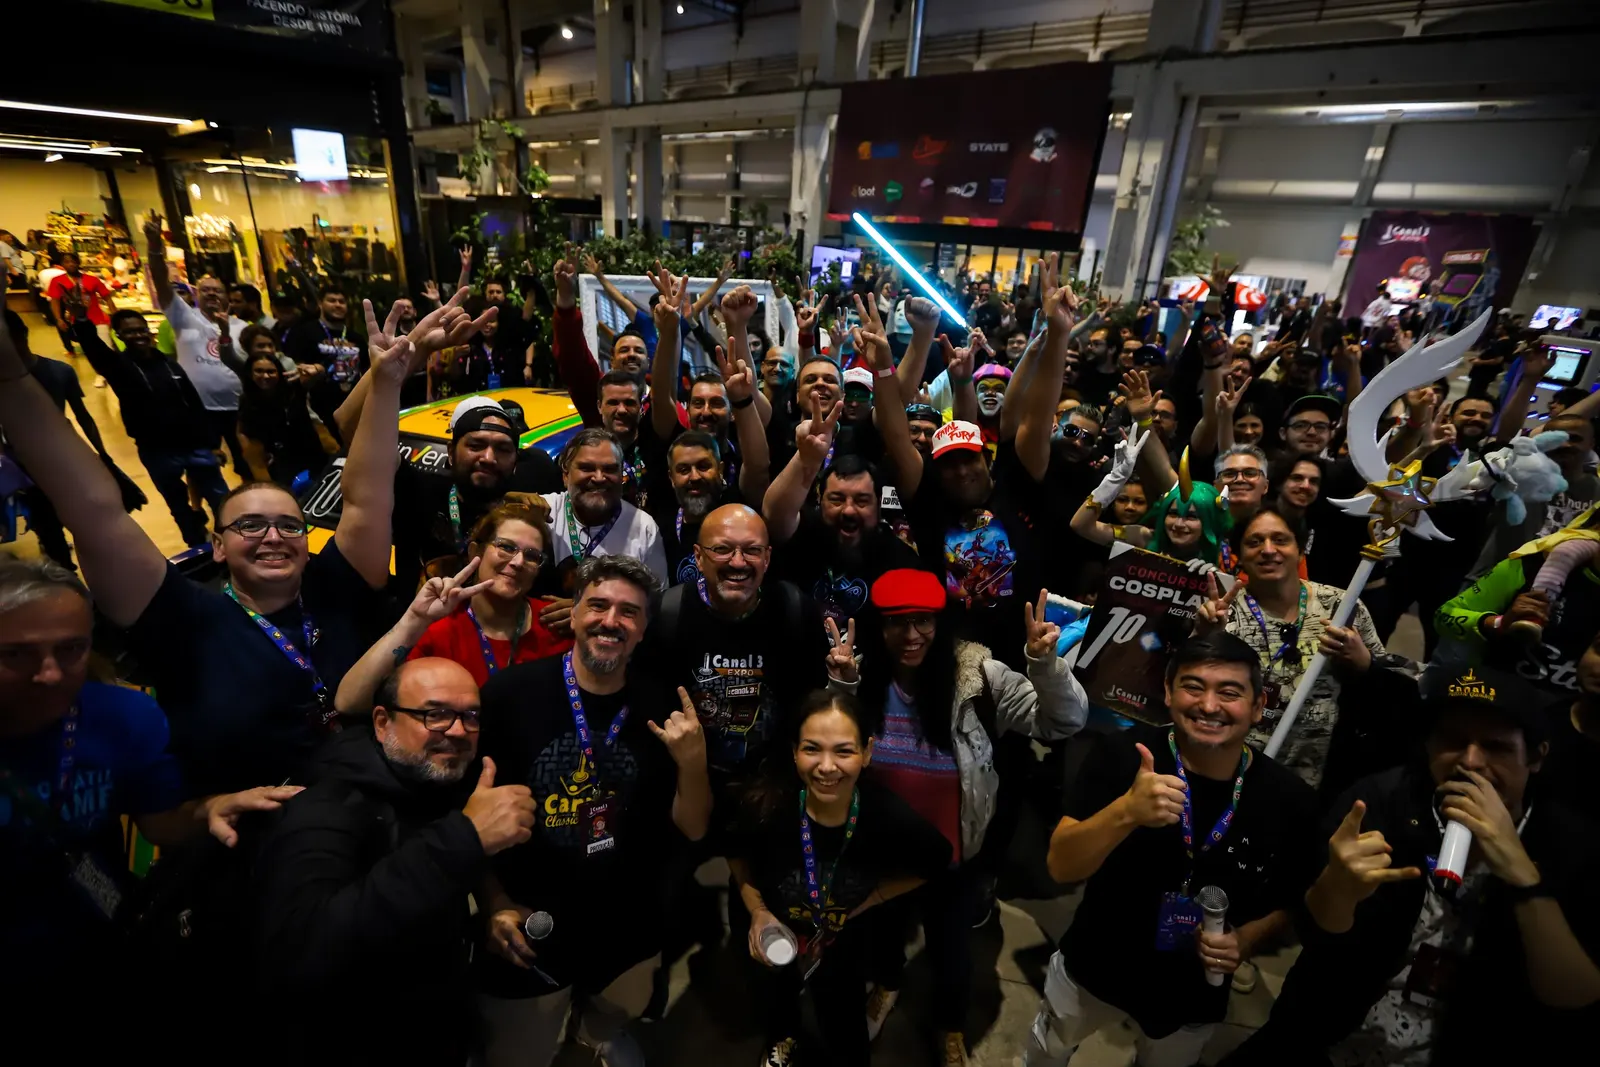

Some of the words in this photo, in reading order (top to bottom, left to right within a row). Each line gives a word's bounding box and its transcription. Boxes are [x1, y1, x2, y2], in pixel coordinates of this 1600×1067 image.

[272, 14, 315, 32] DESDE
[969, 142, 1009, 152] STATE
[935, 422, 959, 440] FATAL
[948, 430, 976, 442] FURY
[1128, 565, 1209, 592] CONCURSO
[1076, 606, 1147, 669] 10
[712, 654, 752, 668] Canal
[756, 655, 764, 668] 3
[1115, 687, 1142, 703] Canal
[1448, 684, 1485, 694] Canal
[545, 814, 580, 828] Classic
